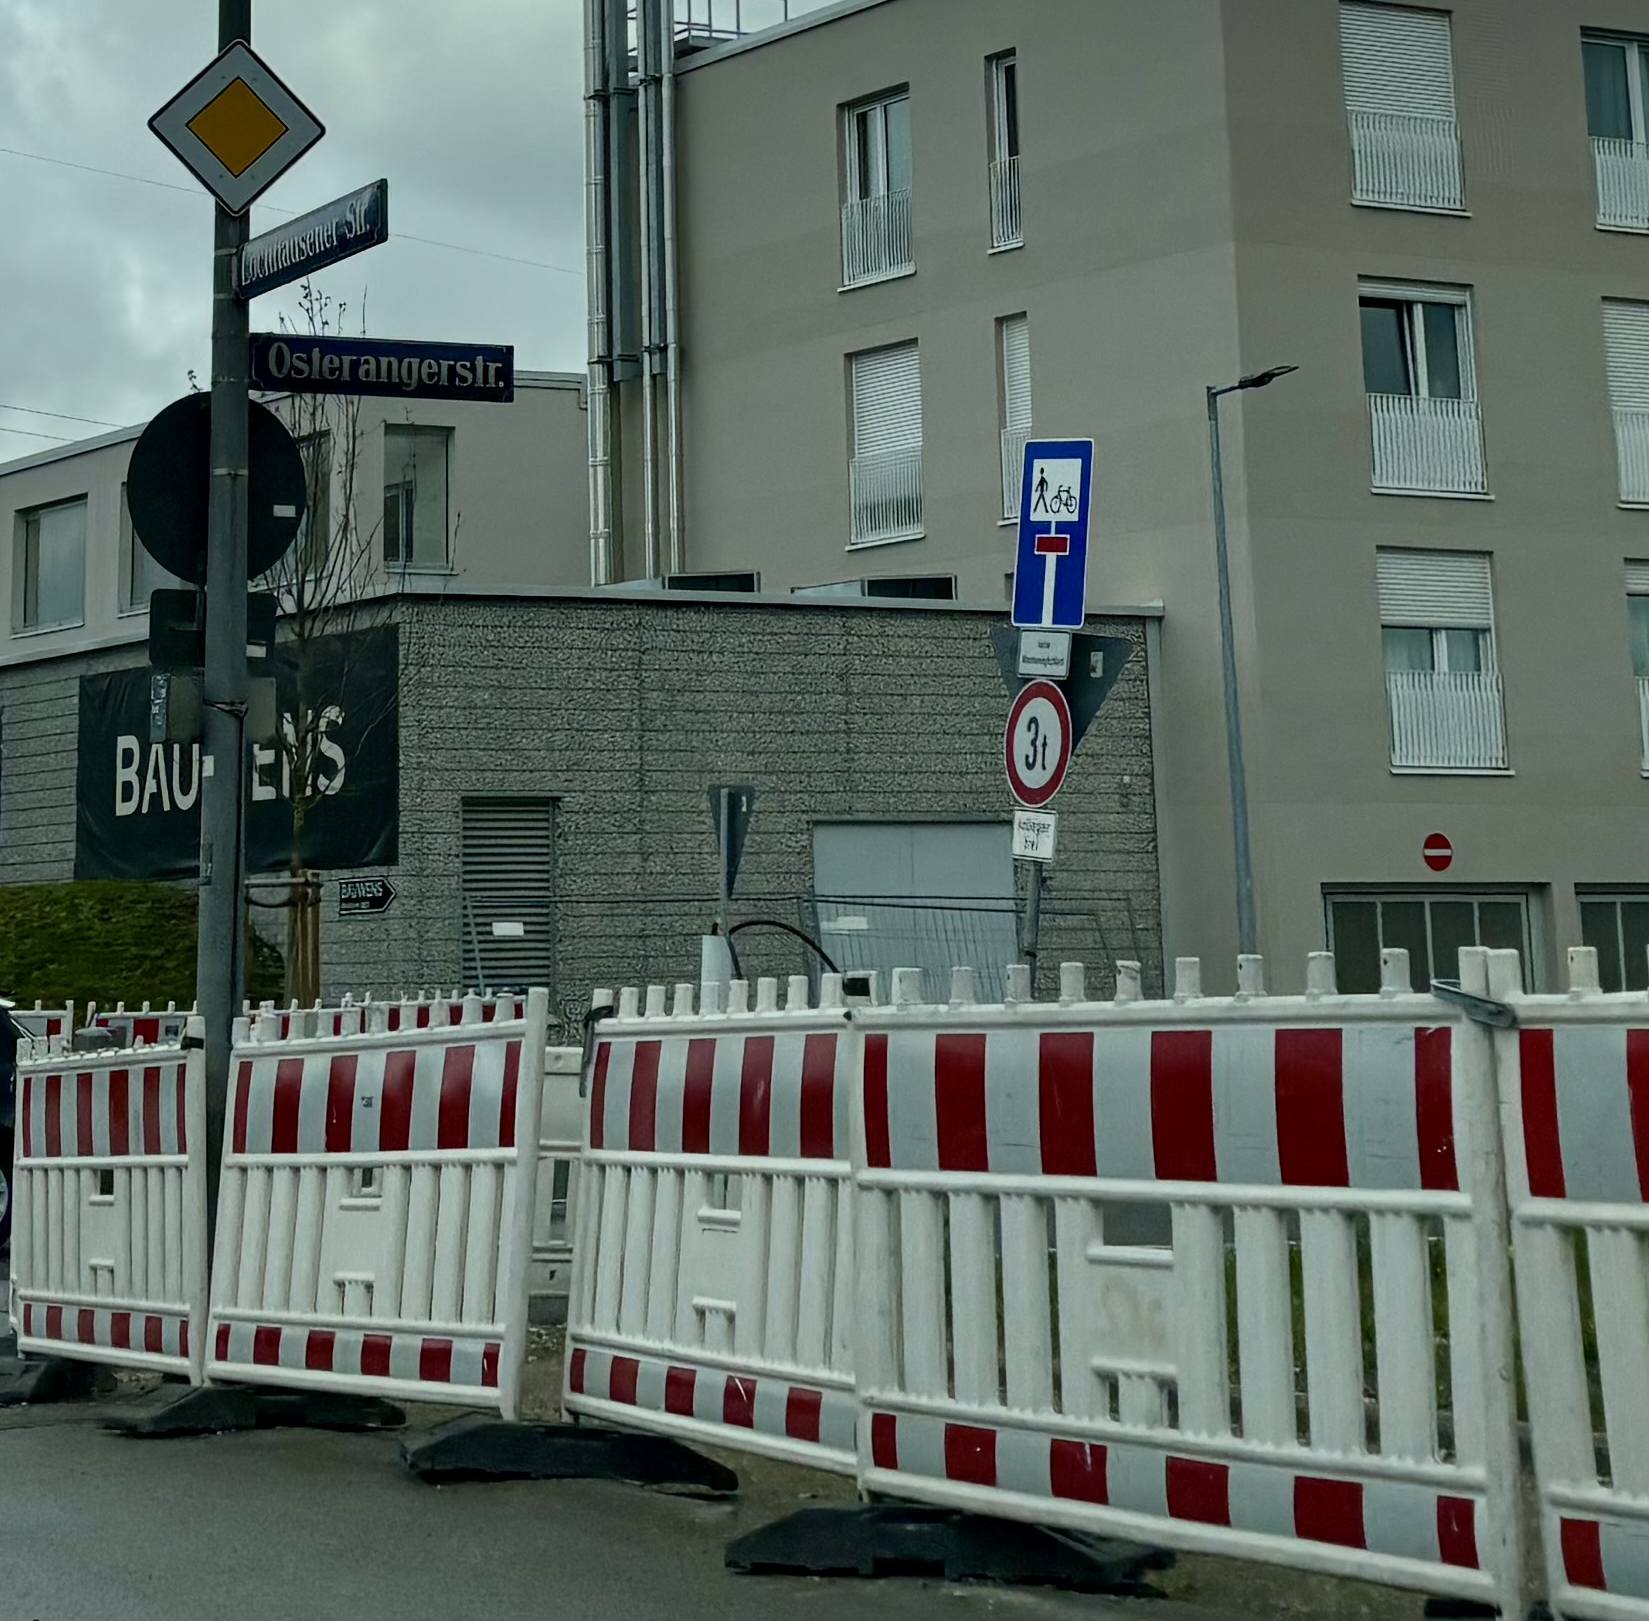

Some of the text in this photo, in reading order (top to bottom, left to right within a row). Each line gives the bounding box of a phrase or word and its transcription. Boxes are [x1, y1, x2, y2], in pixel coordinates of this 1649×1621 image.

[343, 198, 371, 240] Str.
[268, 341, 505, 391] Osterangerstr.
[115, 704, 346, 817] BAUENS
